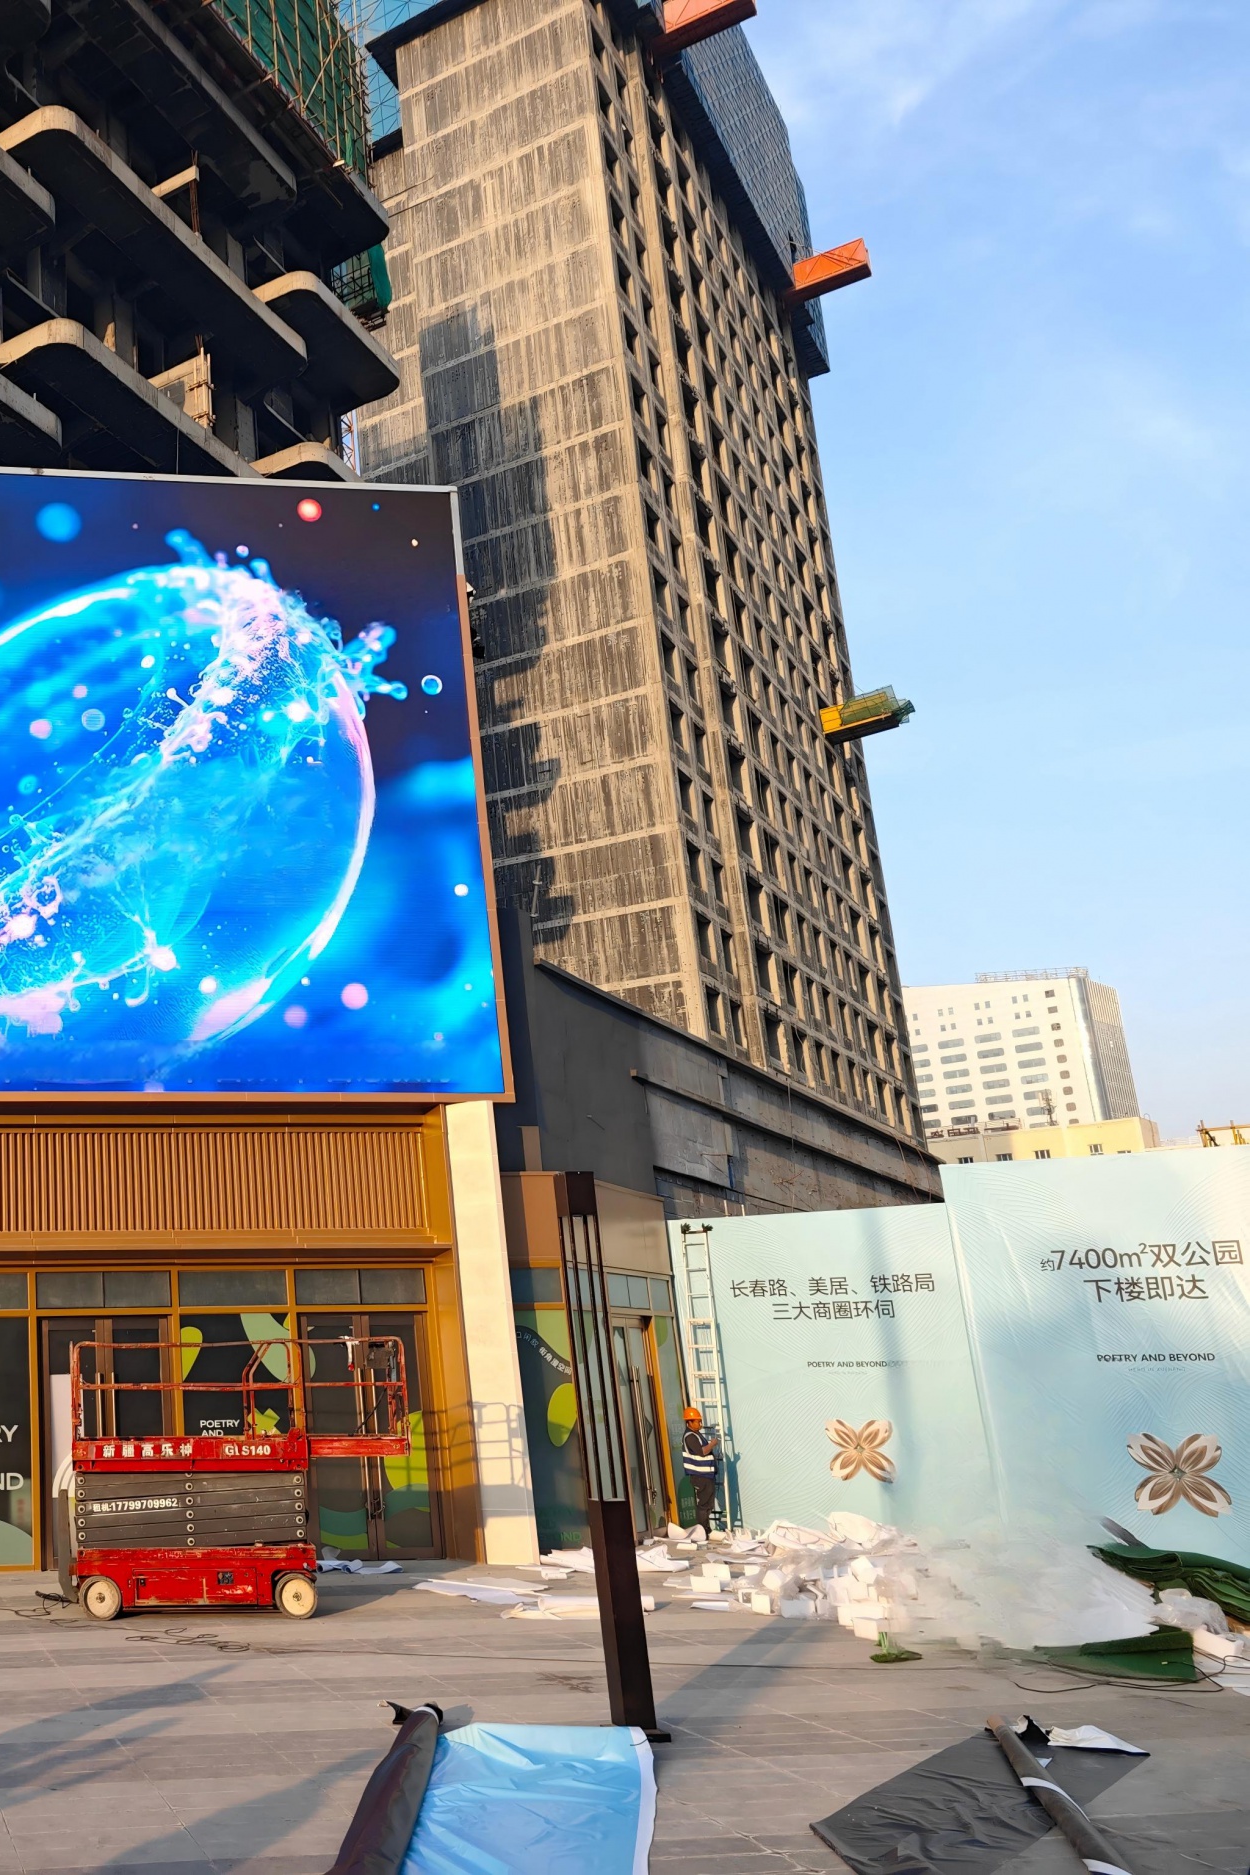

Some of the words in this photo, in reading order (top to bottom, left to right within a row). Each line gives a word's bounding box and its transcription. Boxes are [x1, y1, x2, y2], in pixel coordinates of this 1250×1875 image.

[1083, 1274, 1209, 1303] 下楼即达
[772, 1299, 896, 1321] 三大商圈环伺
[1141, 1353, 1166, 1362] AND
[1169, 1352, 1216, 1362] BEYOND
[856, 1360, 888, 1368] BEYOND
[200, 1419, 240, 1429] POETRY
[201, 1429, 224, 1437] AND
